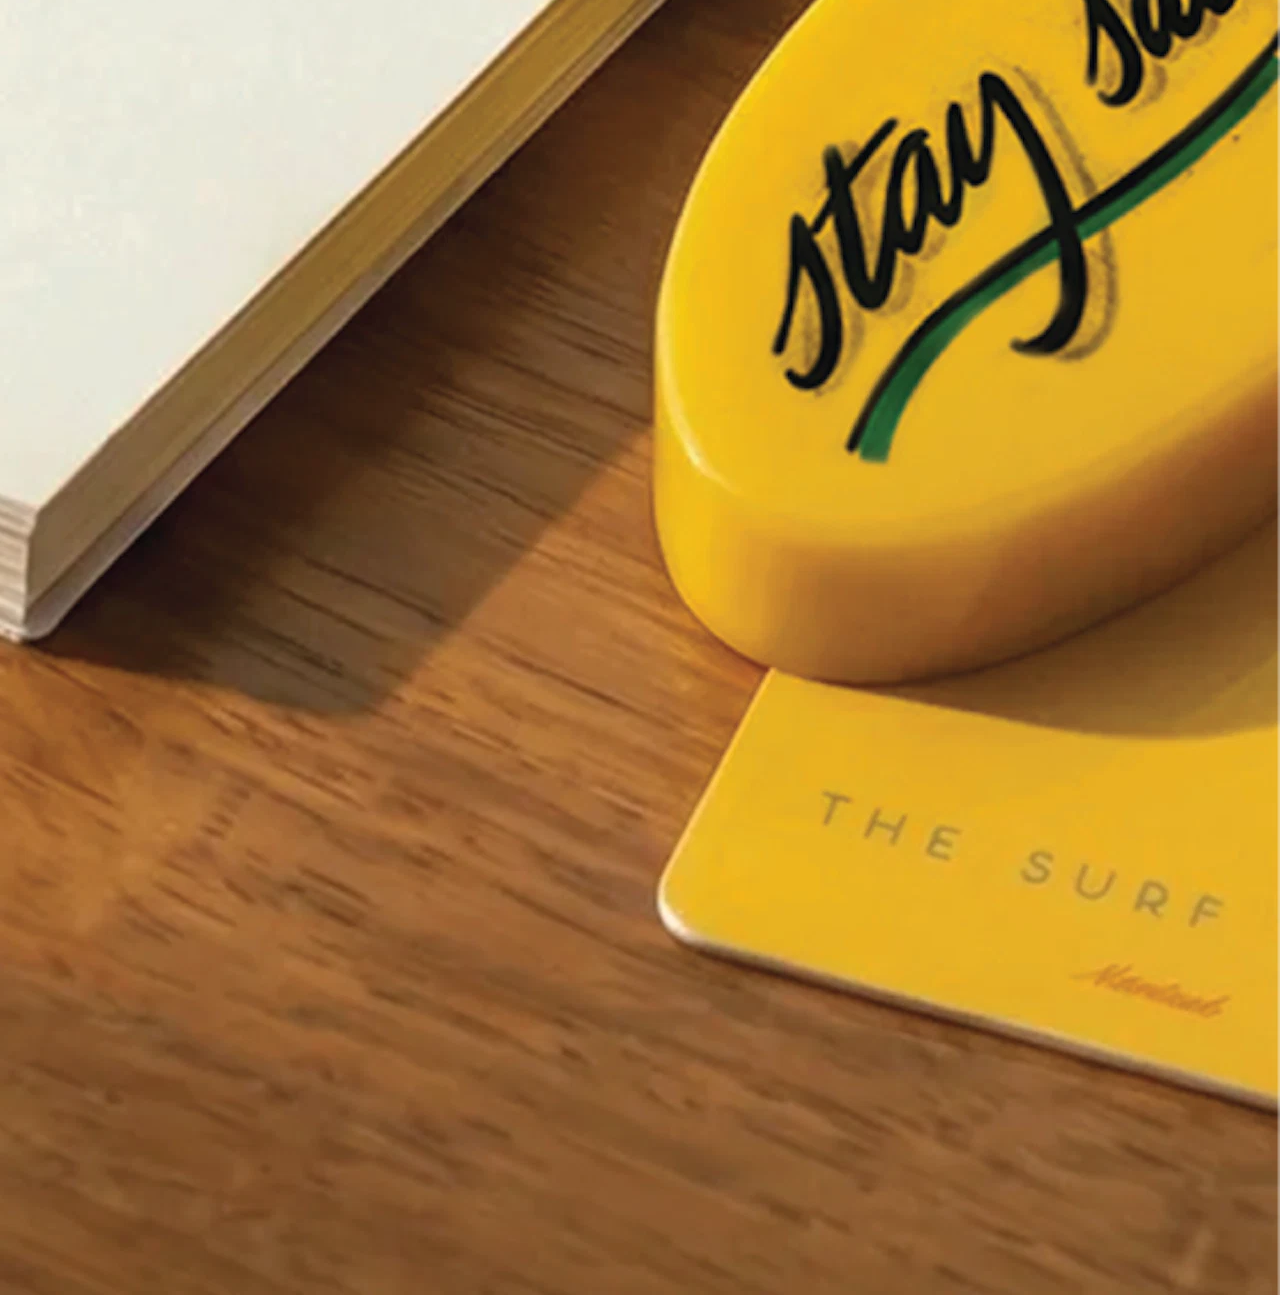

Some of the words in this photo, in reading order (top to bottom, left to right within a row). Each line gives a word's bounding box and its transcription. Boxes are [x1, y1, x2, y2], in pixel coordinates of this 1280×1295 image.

[772, 70, 1088, 390] stay
[820, 791, 961, 861] THE
[1020, 849, 1225, 928] SURF
